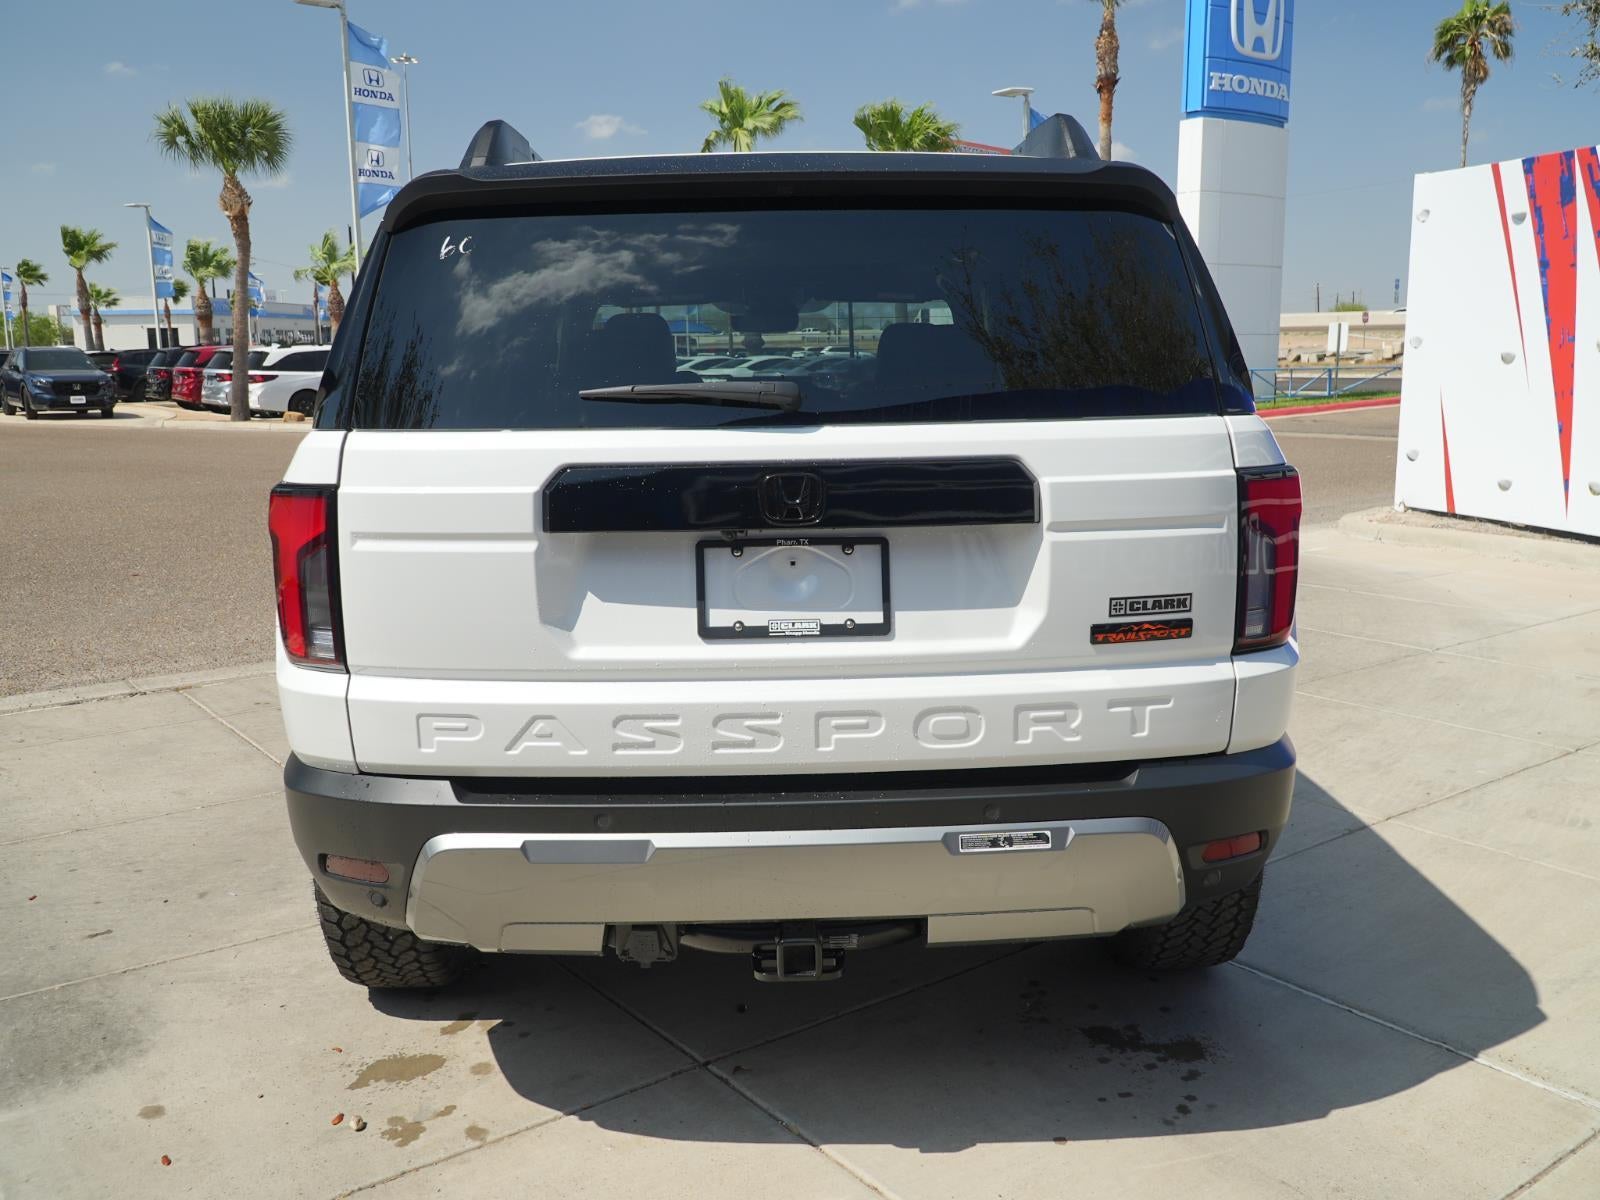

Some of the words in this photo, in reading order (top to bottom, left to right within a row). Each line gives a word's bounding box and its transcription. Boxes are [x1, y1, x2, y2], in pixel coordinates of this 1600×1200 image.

[1209, 72, 1289, 101] HONDA
[354, 87, 395, 102] HONDA
[358, 168, 395, 180] HONDA
[1129, 598, 1188, 612] CLARK
[1094, 628, 1191, 643] TRAILSPORT
[416, 694, 1175, 755] PASSPORT
